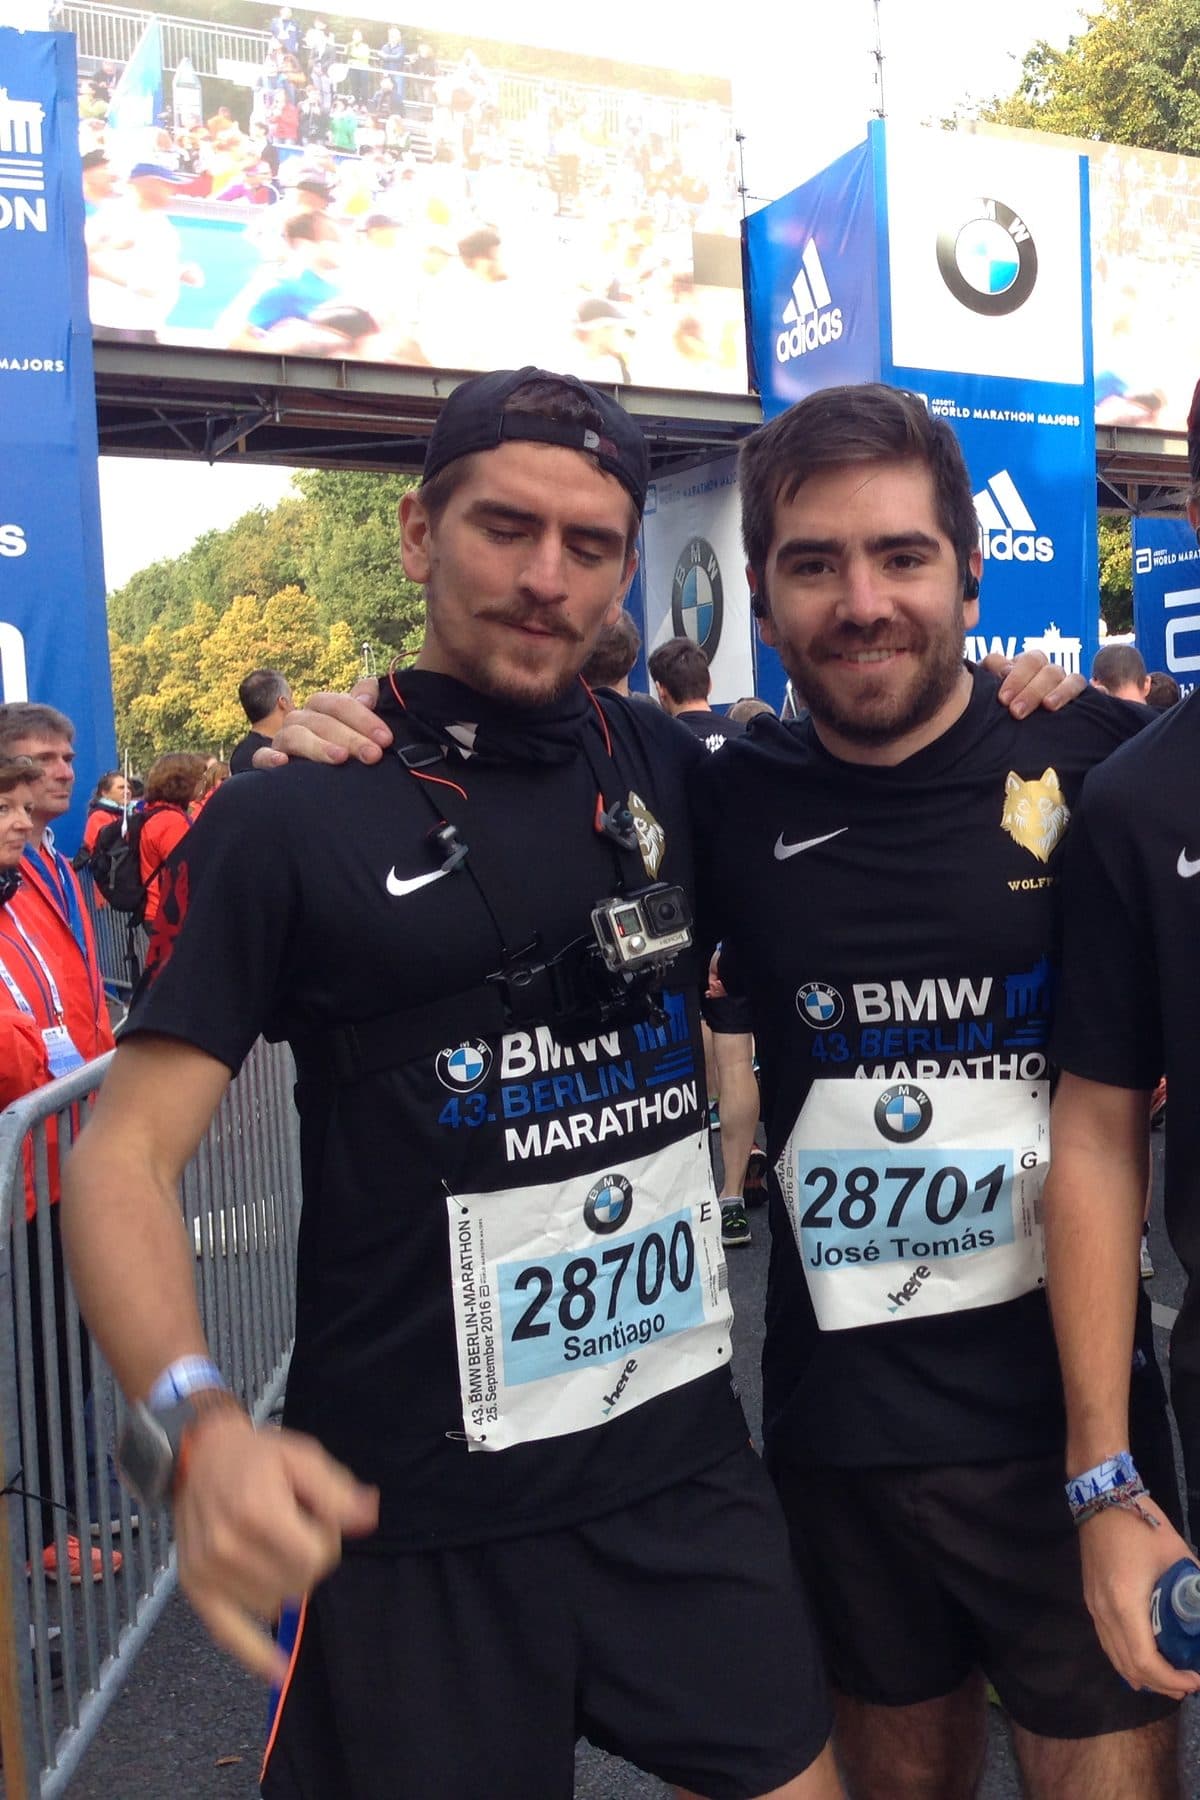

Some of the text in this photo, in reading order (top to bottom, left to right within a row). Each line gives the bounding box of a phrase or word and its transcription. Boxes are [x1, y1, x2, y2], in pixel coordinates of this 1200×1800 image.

[777, 308, 843, 363] adidas
[931, 405, 1080, 427] WORLD MARATHON MAJORS
[674, 542, 720, 586] BMW
[979, 527, 1055, 563] idas
[1153, 554, 1177, 567] WORLD
[852, 976, 993, 1024] BMW
[860, 1021, 993, 1059] BERLIN
[853, 1051, 1047, 1082] MARATHO
[438, 1058, 636, 1129] 43. BERLIN
[881, 1085, 930, 1106] BMW
[504, 1080, 698, 1162] MARATHON
[1020, 1151, 1038, 1170] G
[588, 1175, 629, 1201] BMW
[800, 1163, 1006, 1230] 28701
[700, 1201, 712, 1223] E
[810, 1226, 996, 1268] José Tomás
[511, 1219, 696, 1342] 28700
[889, 1265, 931, 1307] here
[457, 1219, 485, 1426] 43. BMW BERLIN-MARATHON
[563, 1312, 666, 1362] Santiago
[479, 1301, 498, 1424] 25. September 2016
[603, 1358, 639, 1407] here
